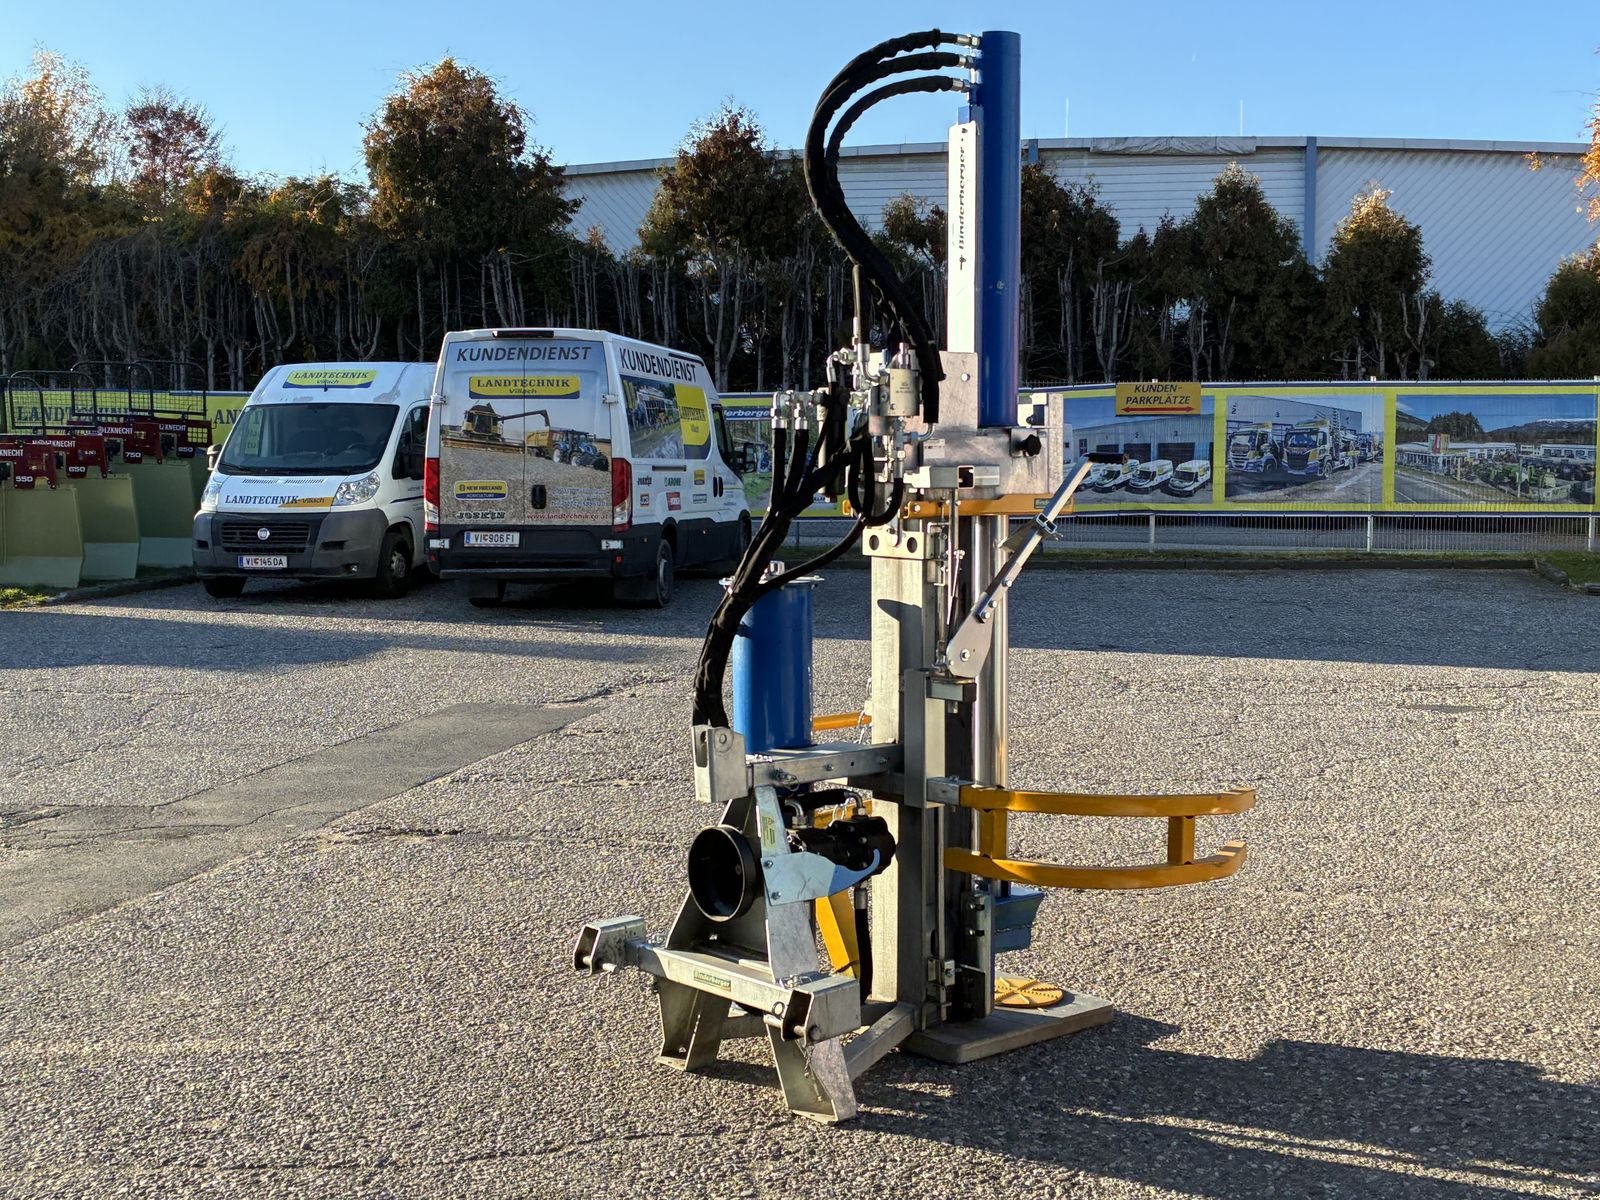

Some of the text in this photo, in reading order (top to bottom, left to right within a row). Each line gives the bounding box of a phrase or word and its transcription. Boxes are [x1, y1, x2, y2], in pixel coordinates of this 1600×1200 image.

[456, 346, 592, 362] KUNDENDIENST
[619, 347, 697, 382] KUNDENDIENST
[293, 371, 369, 379] LANDTECHNIK
[476, 378, 570, 388] LANDTECHNIK
[1134, 384, 1182, 393] KUNDEN-
[1125, 393, 1191, 405] PARKPLÄTZE
[723, 409, 770, 418] erberge
[225, 495, 299, 505] LANDTECHNIK
